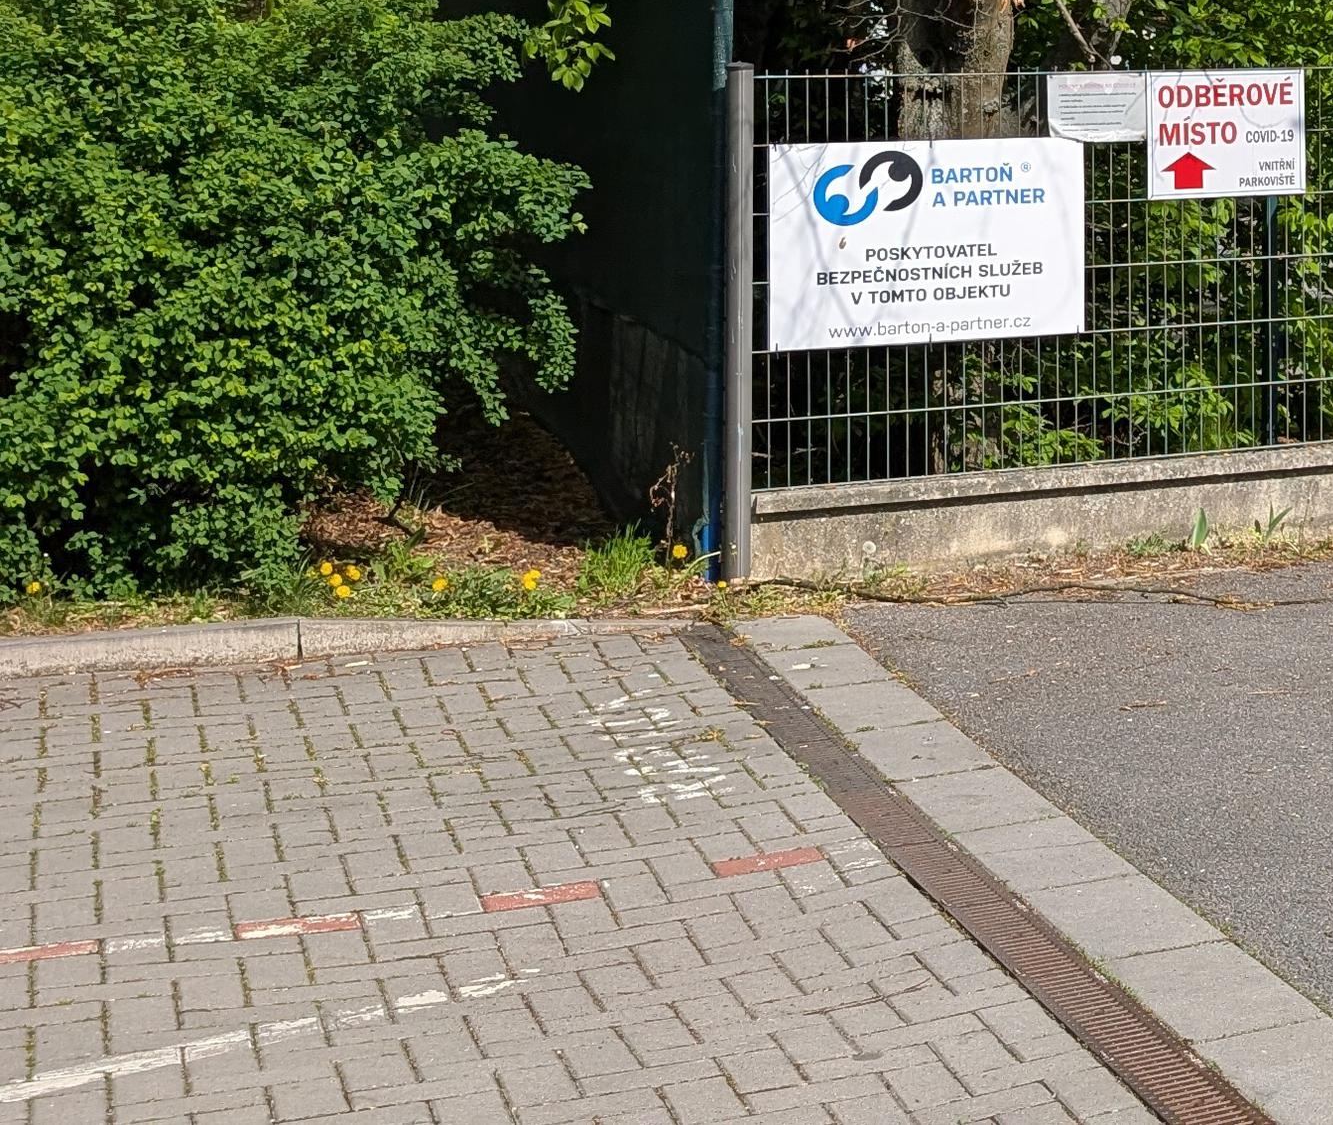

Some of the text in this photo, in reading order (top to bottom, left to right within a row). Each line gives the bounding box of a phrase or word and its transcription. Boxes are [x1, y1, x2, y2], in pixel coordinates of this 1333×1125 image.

[1158, 78, 1293, 108] ODBĚROVÉ
[1160, 117, 1296, 146] MÍSTO COVID-19
[931, 160, 1012, 183] BARTOŇ
[1258, 158, 1296, 172] VNITŘNÍ
[1239, 173, 1295, 187] PARKOVIŠTĚ
[933, 188, 1045, 207] A PARTNER
[866, 244, 997, 261] POSKYTOVATEL
[817, 260, 1043, 285] BEZPEČNOSTNÍCH SLUŽEB
[851, 284, 1010, 305] V TOMTO OBJEKTU
[829, 316, 1032, 339] www.barton-a-partner.cz
